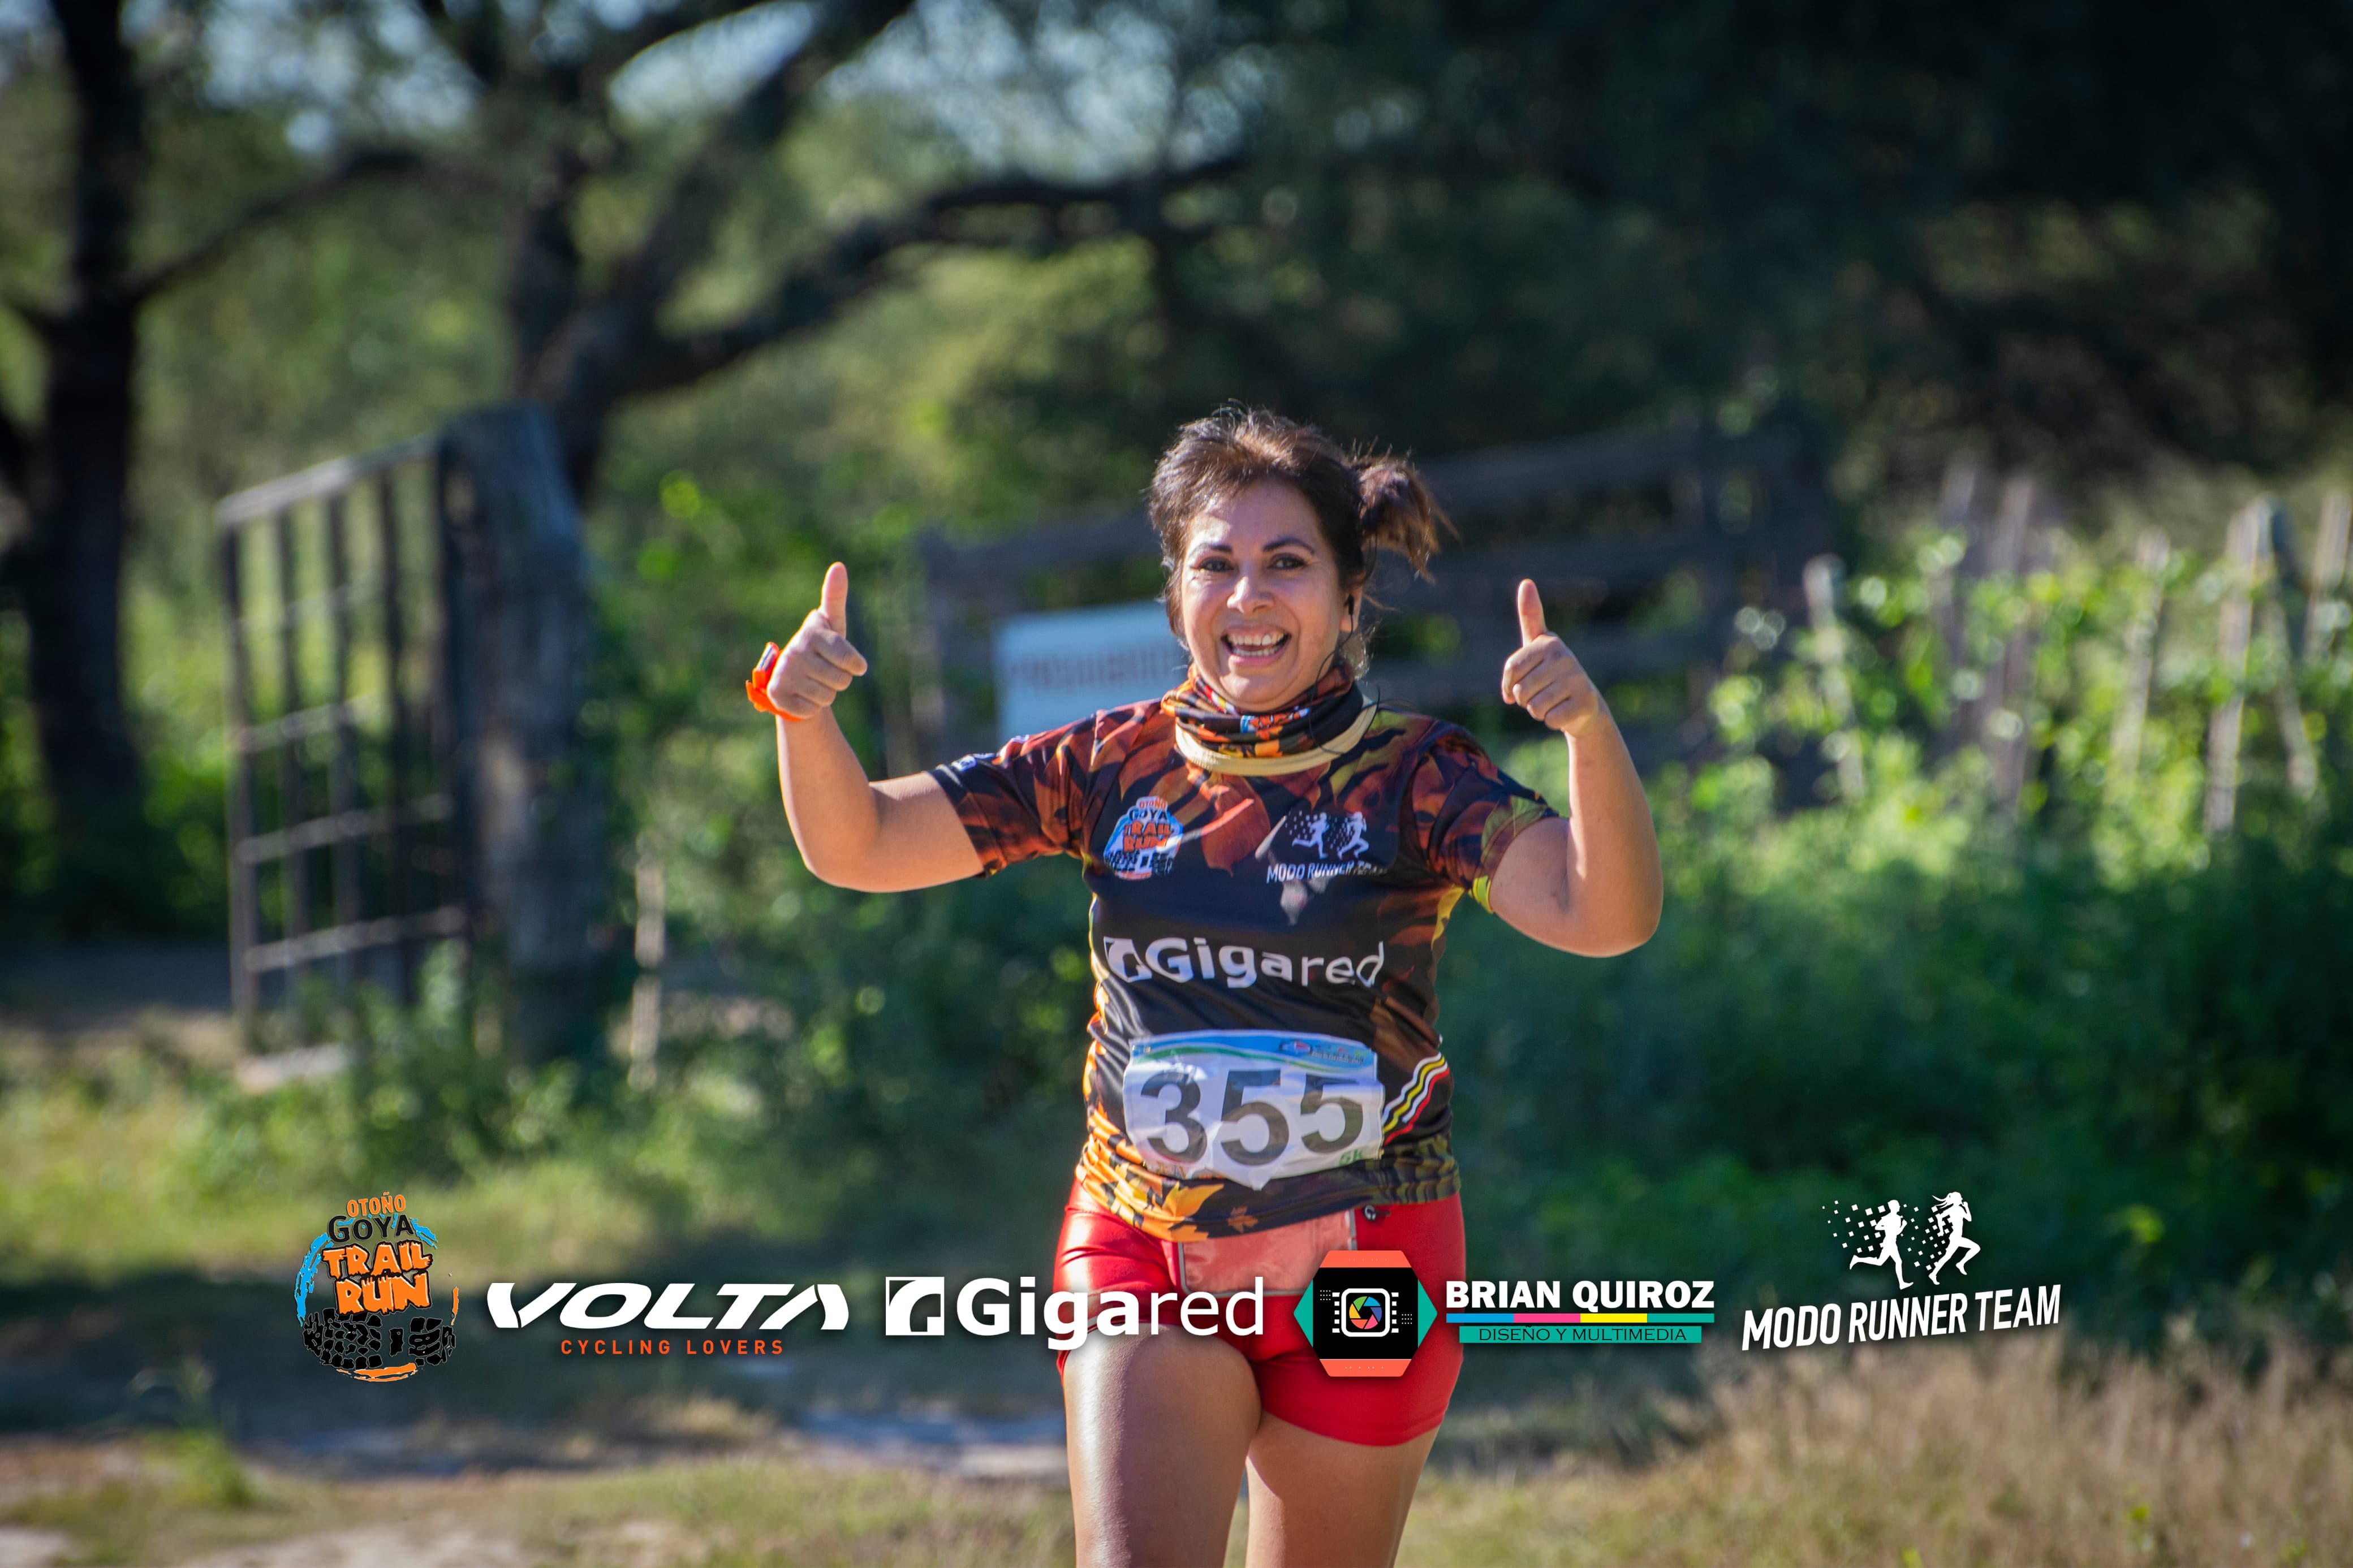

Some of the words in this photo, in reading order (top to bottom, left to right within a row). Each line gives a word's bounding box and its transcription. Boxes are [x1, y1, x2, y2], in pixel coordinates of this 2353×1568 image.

[1124, 821, 1173, 835] TRAIL
[1123, 835, 1168, 852] RUN
[1266, 863, 1305, 884] MODO
[1307, 860, 1355, 879] RUNNER
[1145, 936, 1384, 988] Gigared
[1140, 1069, 1364, 1166] 355
